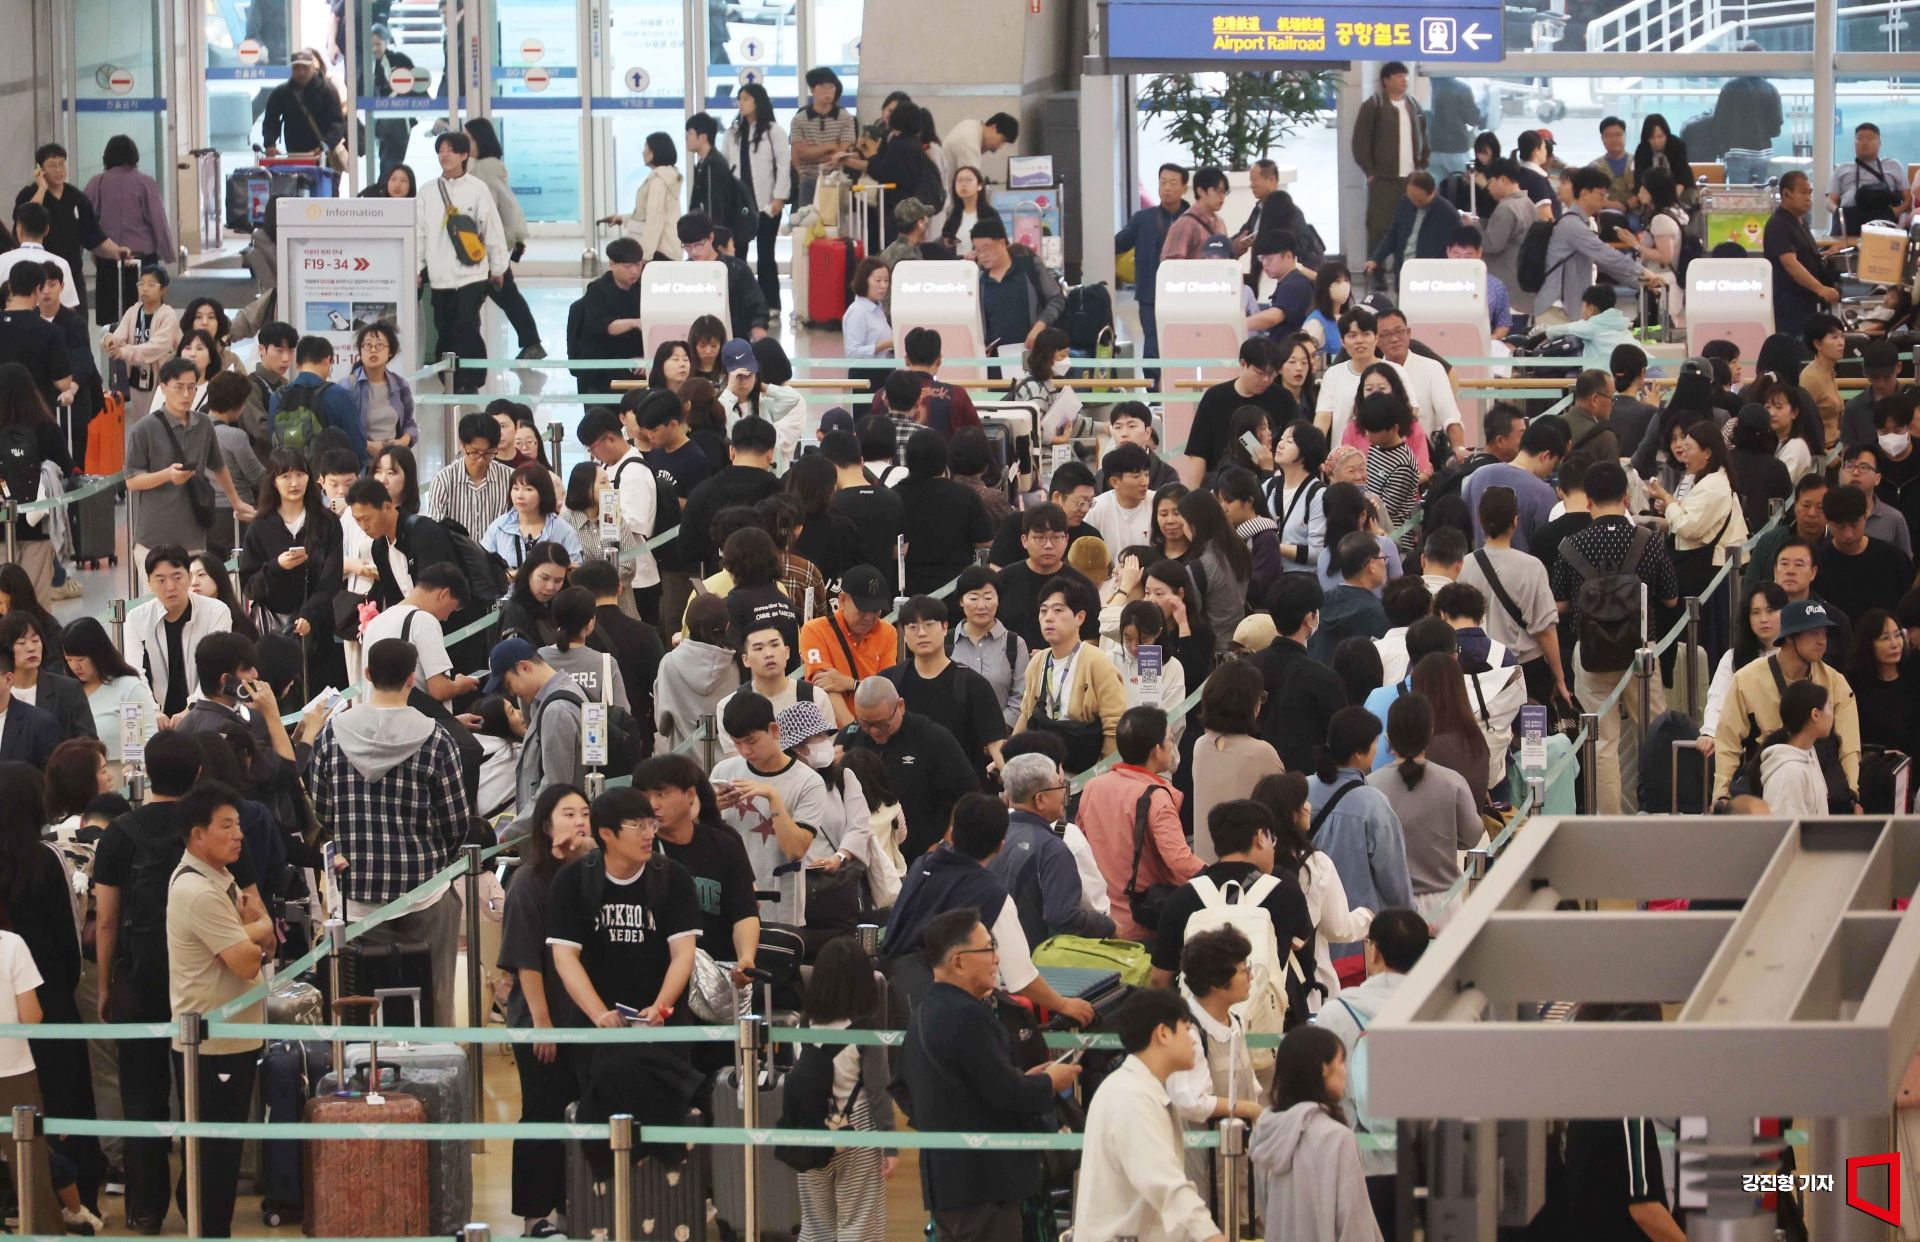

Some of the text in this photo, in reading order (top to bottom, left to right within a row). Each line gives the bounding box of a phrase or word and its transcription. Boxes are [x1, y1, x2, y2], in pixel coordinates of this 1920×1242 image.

[1335, 22, 1411, 46] 공항철도
[1213, 35, 1326, 53] Airport Railroad
[375, 100, 431, 108] DO NOT EXIT
[326, 208, 384, 217] Information
[304, 258, 324, 270] F19
[333, 258, 349, 270] 34
[651, 283, 717, 294] Self Check-in
[901, 282, 967, 293] Self Check-in
[1166, 282, 1232, 293] Self Check-in
[1410, 280, 1475, 292] Self Check-in
[1696, 280, 1762, 291] Self Check-in
[569, 671, 597, 688] ERS
